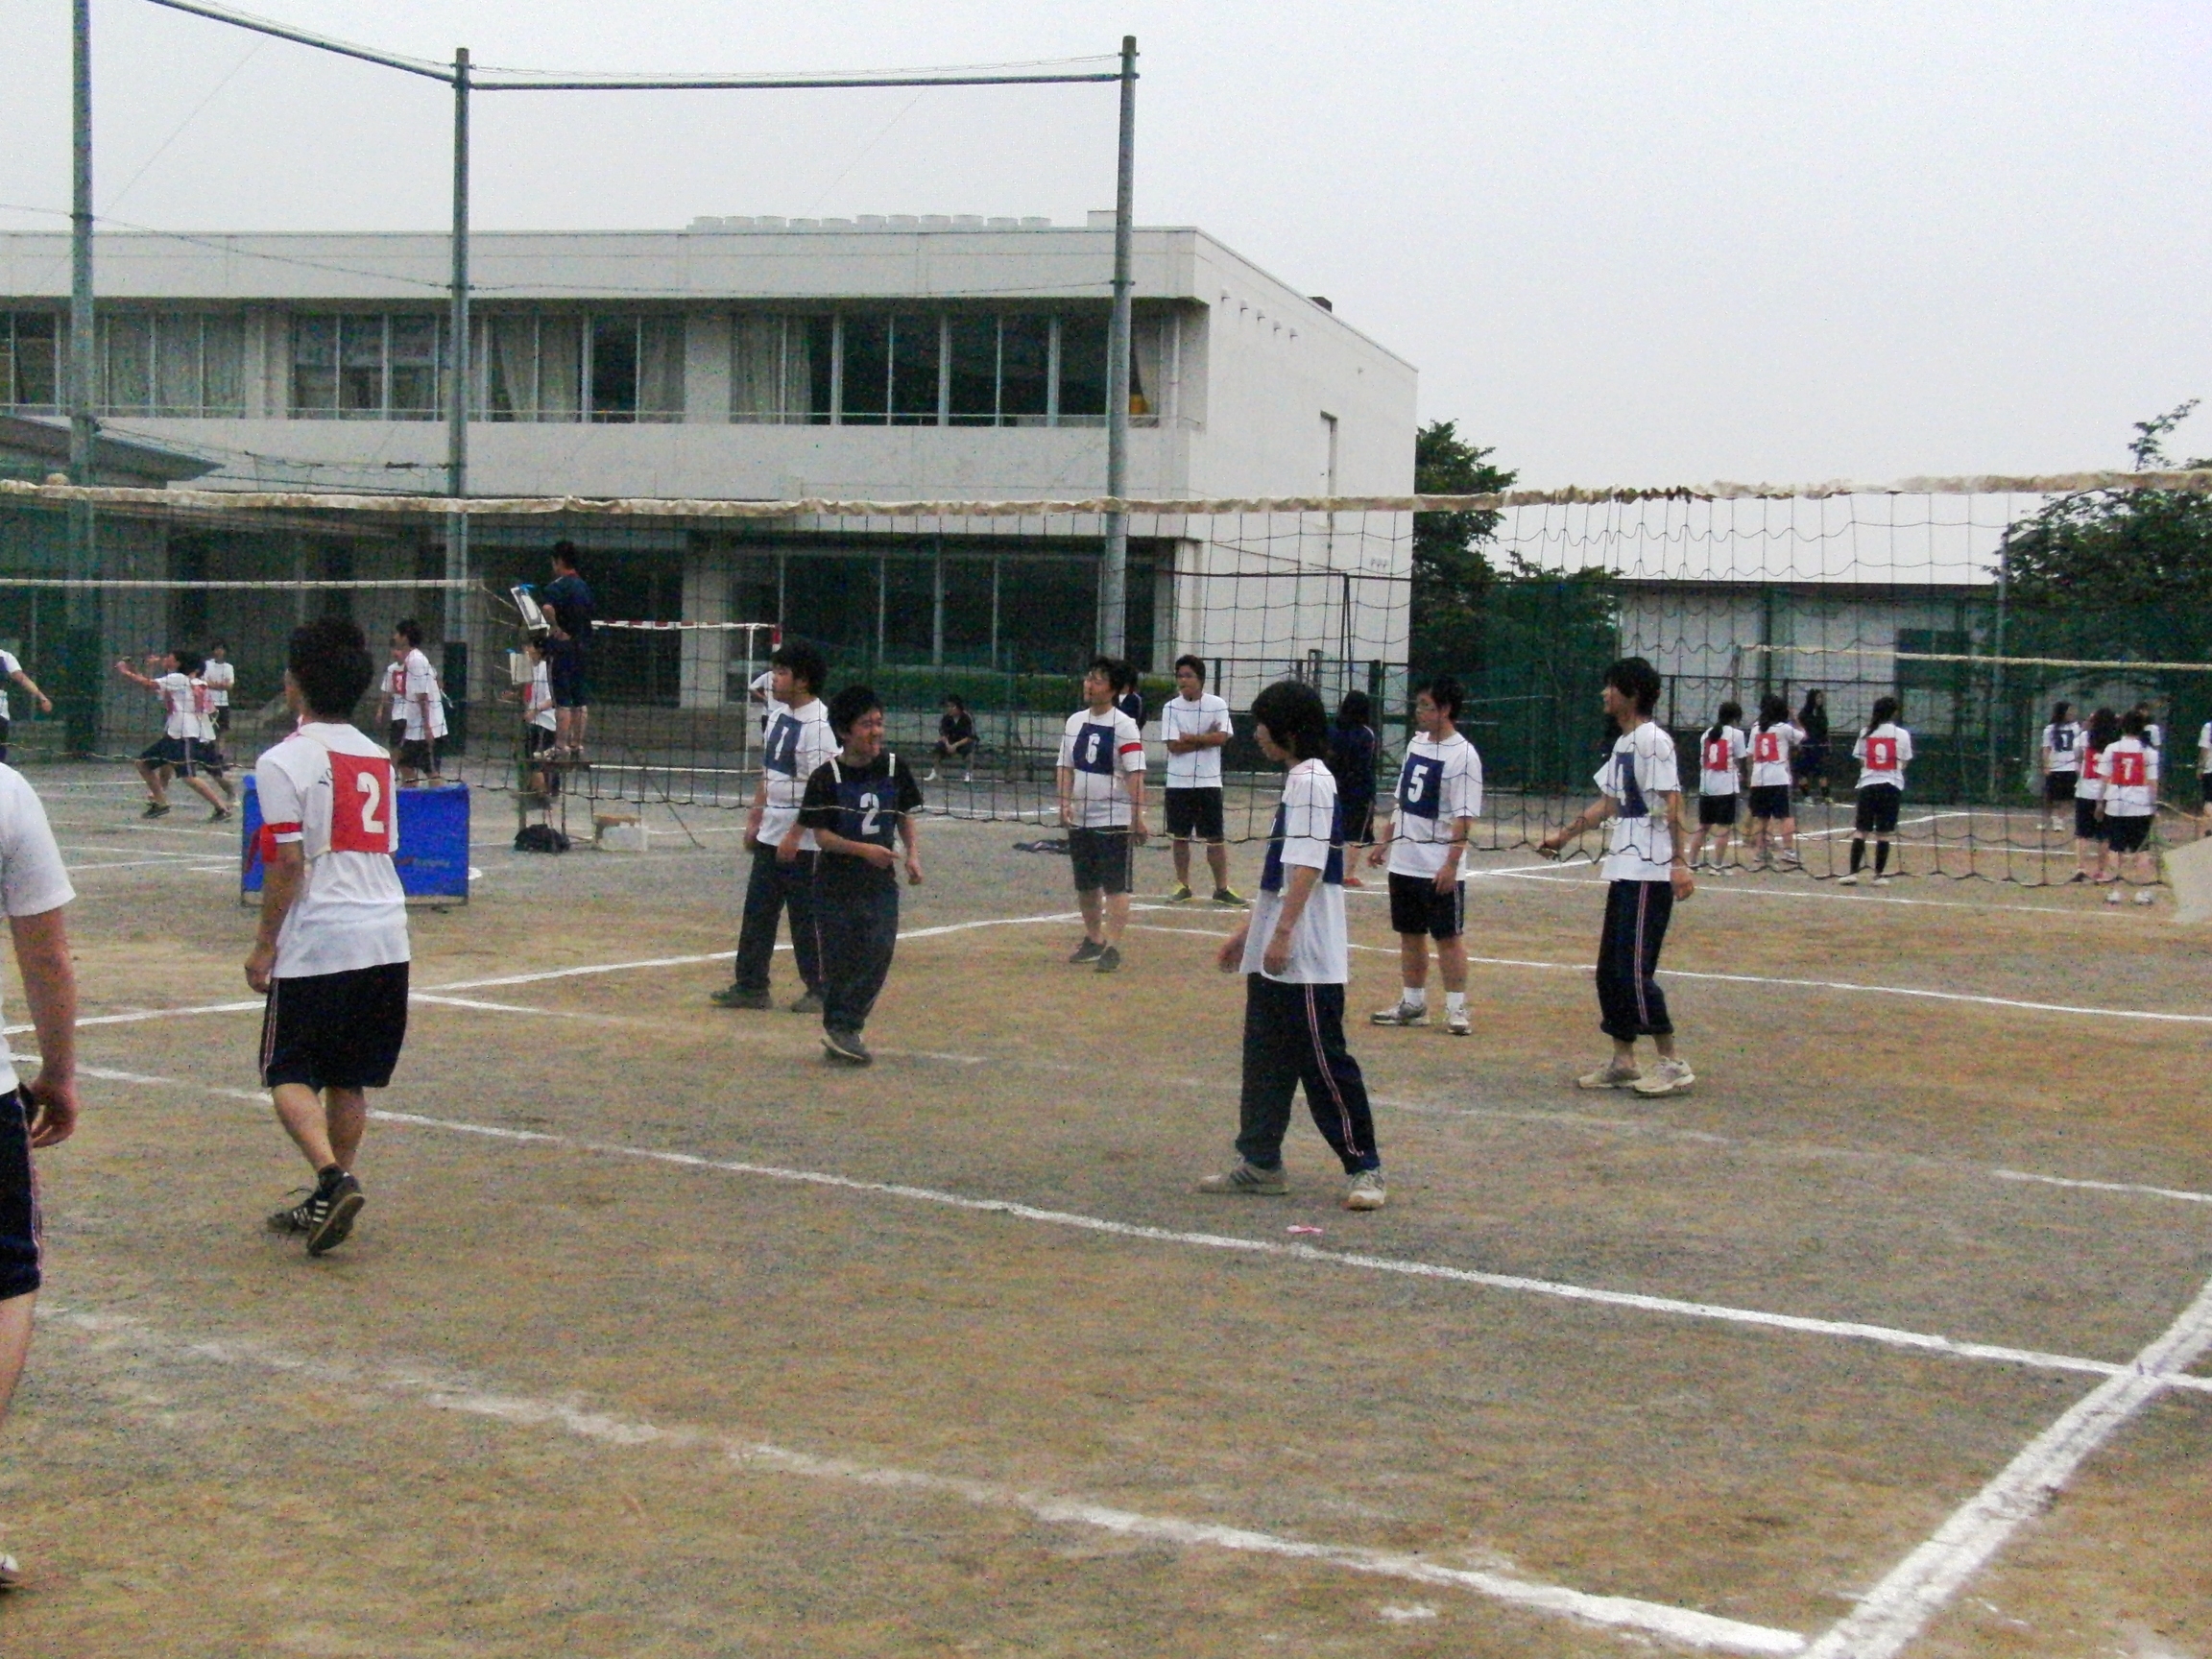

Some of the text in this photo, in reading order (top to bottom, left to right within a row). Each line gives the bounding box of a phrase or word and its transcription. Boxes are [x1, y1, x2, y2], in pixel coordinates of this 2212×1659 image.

[1086, 733, 1100, 764] 6
[1875, 743, 1887, 764] 9
[356, 771, 385, 833] 2
[1407, 764, 1429, 803] 5
[860, 793, 880, 835] 2
